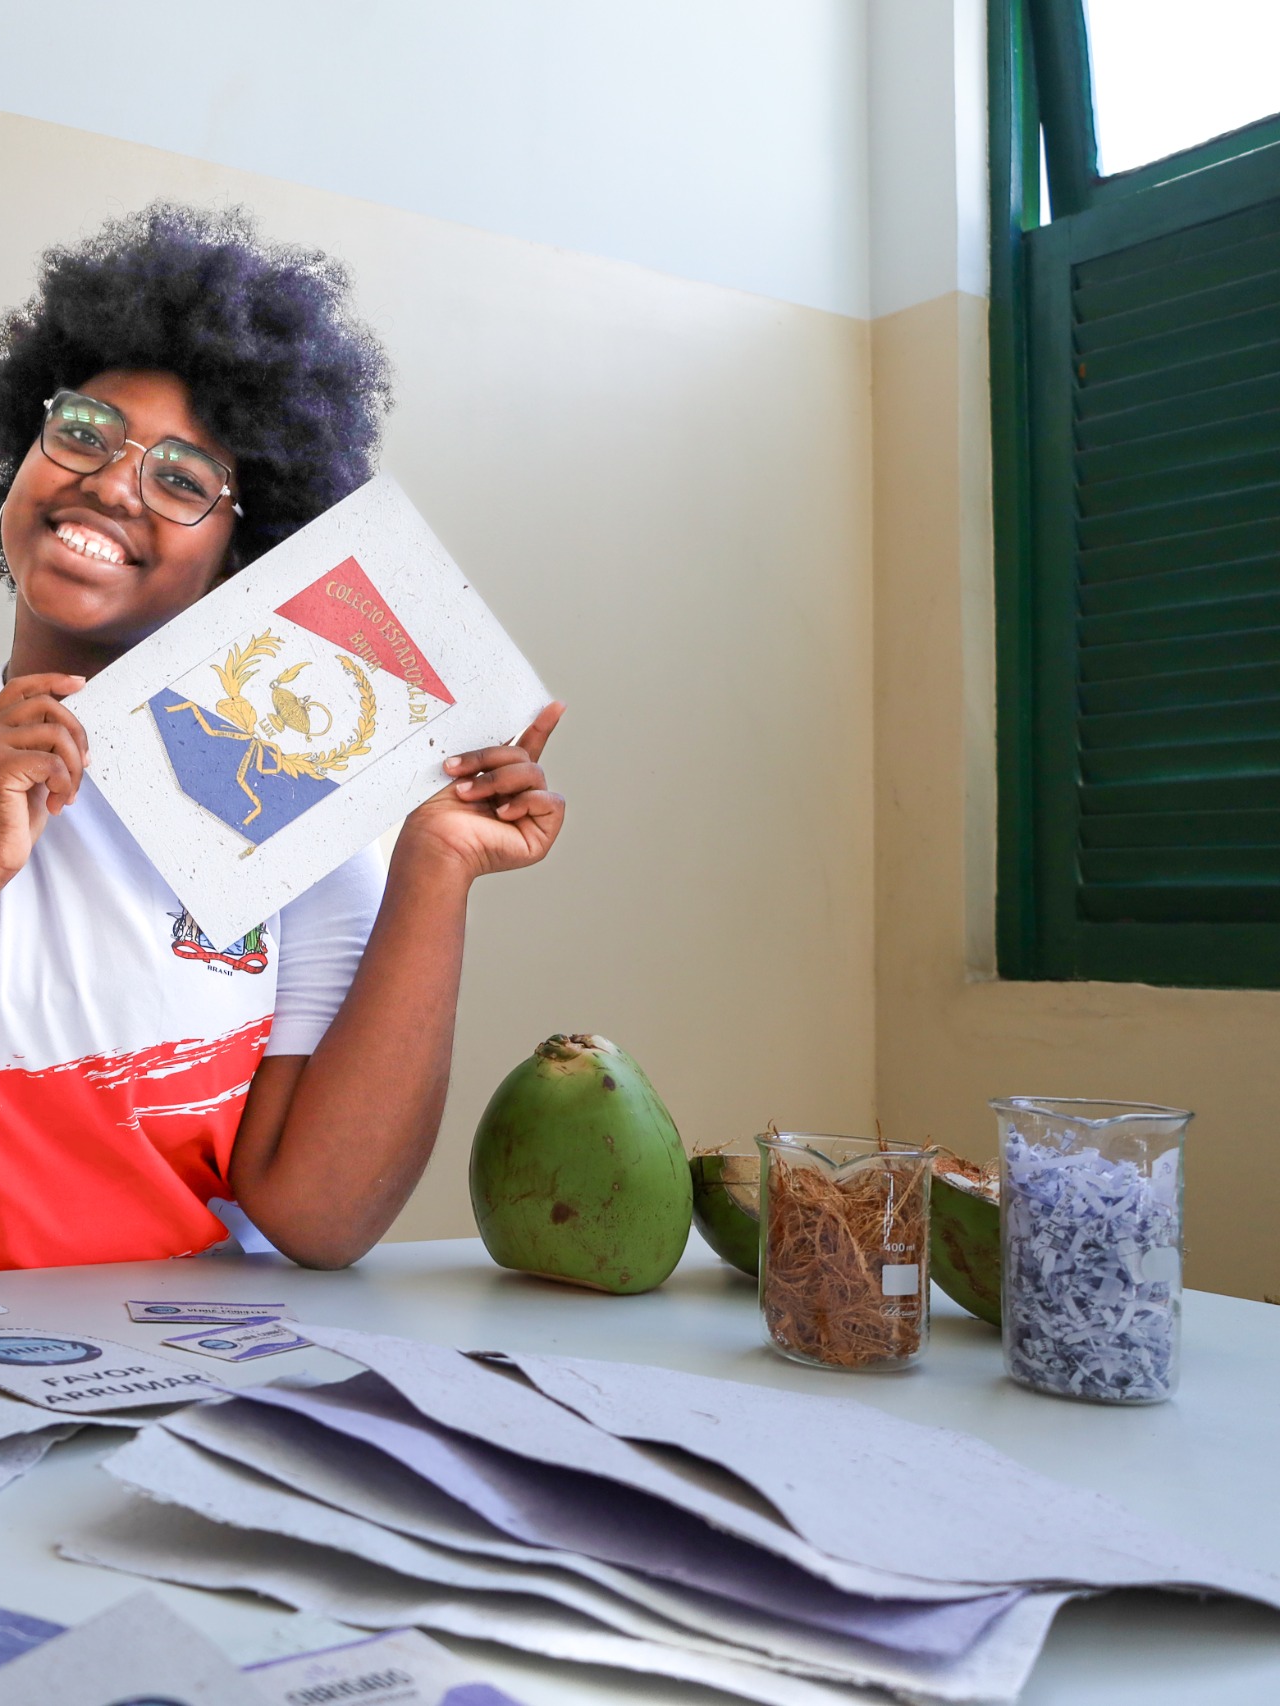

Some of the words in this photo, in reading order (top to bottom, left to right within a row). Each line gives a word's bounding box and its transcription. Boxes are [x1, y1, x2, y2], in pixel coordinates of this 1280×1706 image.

[348, 629, 384, 675] BAHIA
[258, 718, 277, 740] LUX
[884, 1242, 906, 1252] 400
[41, 1365, 155, 1387] FAVOR
[44, 1374, 212, 1404] ARRUMAR
